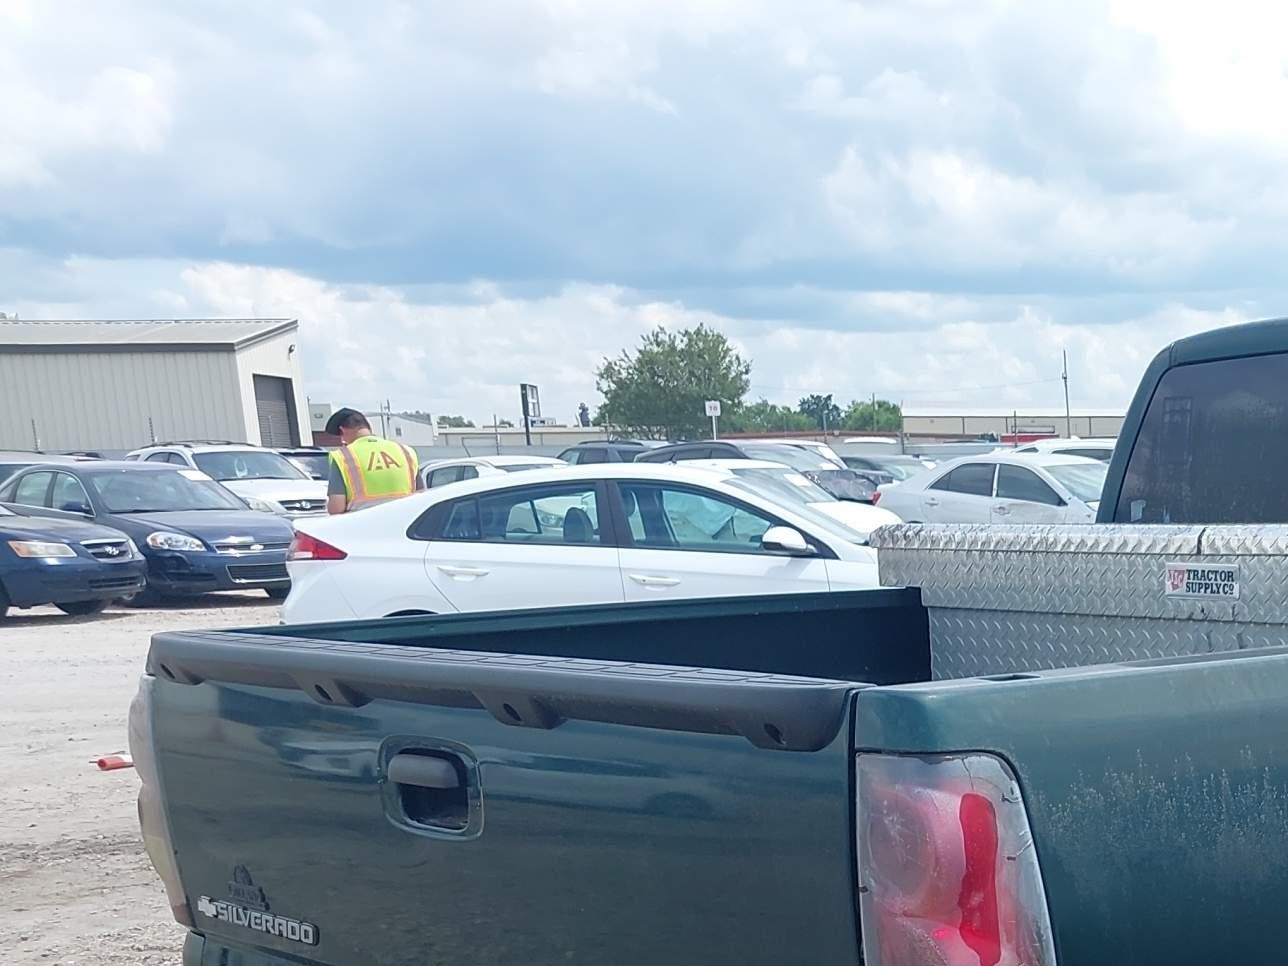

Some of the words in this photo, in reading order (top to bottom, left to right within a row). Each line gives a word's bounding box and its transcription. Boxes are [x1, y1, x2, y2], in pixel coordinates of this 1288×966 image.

[1185, 569, 1235, 583] TRACTOR
[1185, 581, 1222, 595] SUPPLY
[216, 901, 319, 946] SILVERADO
